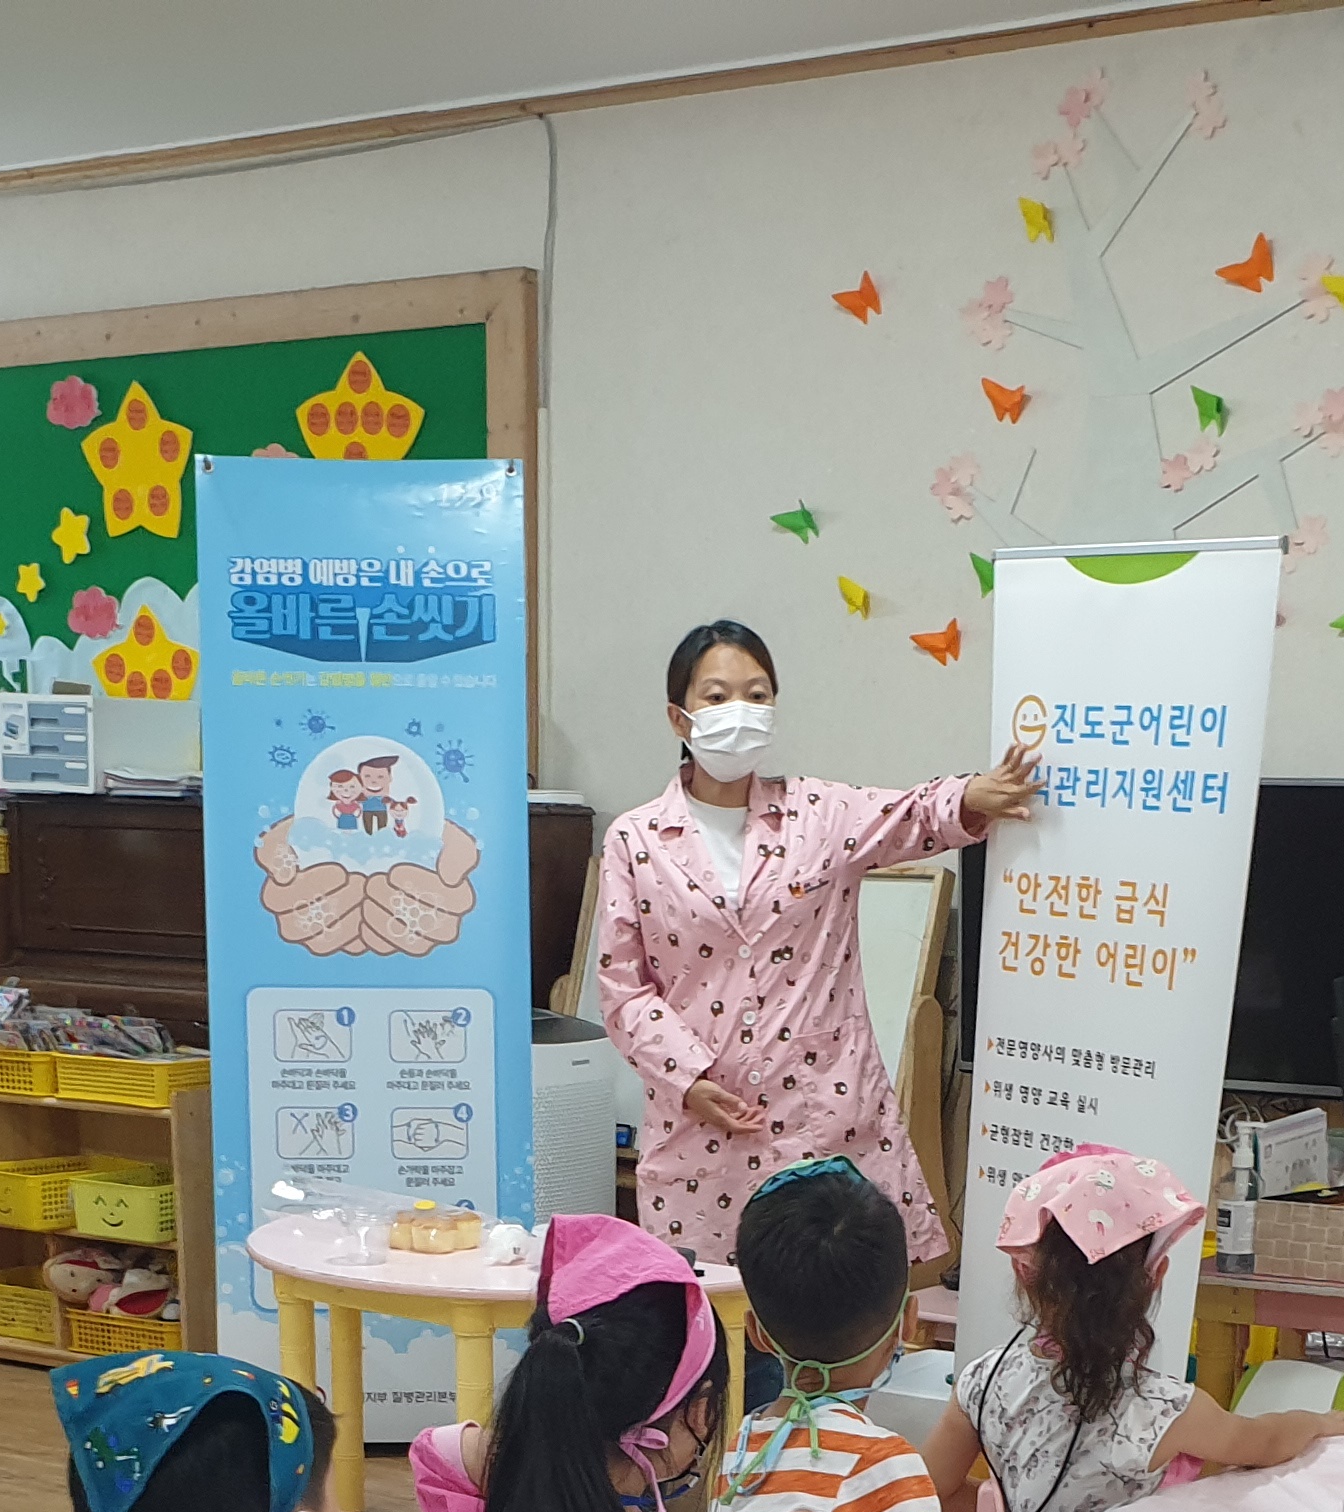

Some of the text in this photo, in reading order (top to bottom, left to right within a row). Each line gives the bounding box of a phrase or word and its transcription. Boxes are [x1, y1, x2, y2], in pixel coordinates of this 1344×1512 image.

[229, 557, 493, 587] 감염병 예방은 내 손으로
[228, 589, 497, 643] 올바른 손씻기
[1051, 703, 1228, 748] 진도군어린이
[1032, 765, 1229, 814] 식관리지원센터
[1115, 880, 1169, 927] 급식
[999, 930, 1082, 979] 건강한
[996, 1037, 1066, 1064] 전문영양사의
[1110, 1054, 1156, 1079] 방문관리
[1019, 1085, 1042, 1105] 영양
[1047, 1090, 1070, 1110] 교육
[1077, 1095, 1098, 1115] 실시
